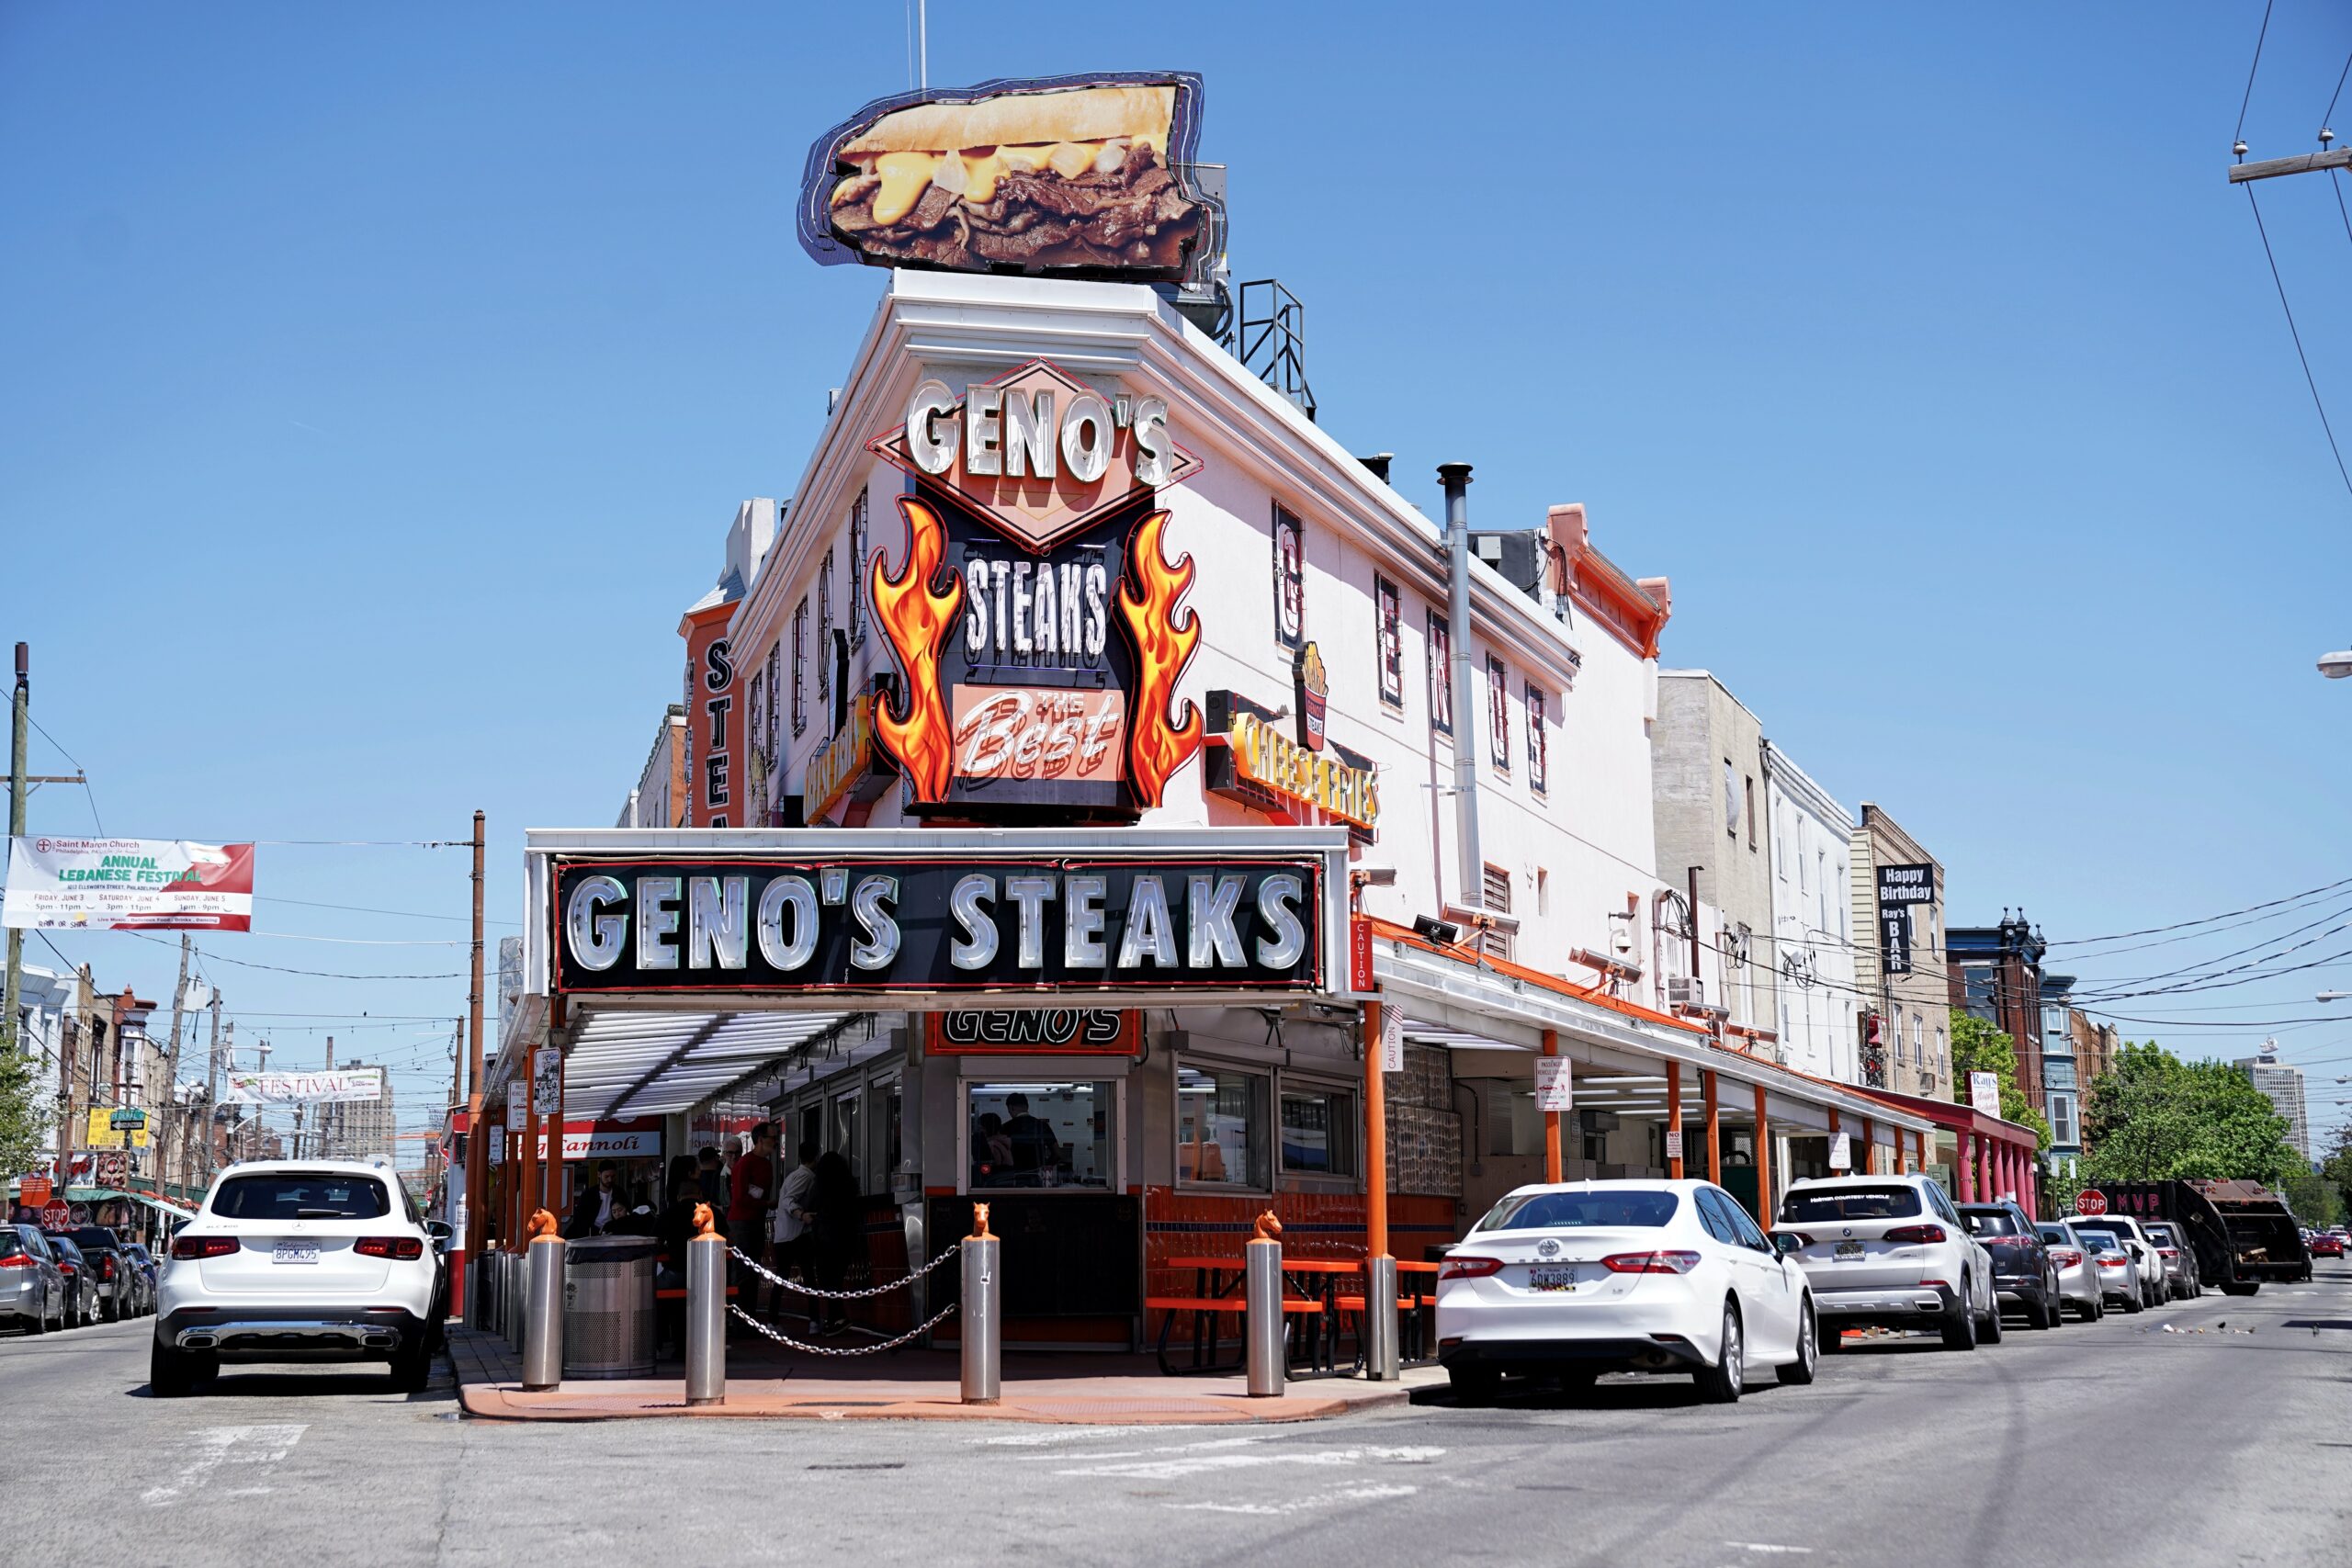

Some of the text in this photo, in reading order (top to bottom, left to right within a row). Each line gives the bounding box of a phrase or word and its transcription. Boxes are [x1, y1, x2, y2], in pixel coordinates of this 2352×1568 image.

[908, 378, 1174, 487] GENO'S
[967, 558, 1106, 656] STEAKS
[1037, 692, 1084, 713] THE
[958, 690, 1121, 773] Best
[56, 840, 78, 848] Saint
[81, 840, 107, 849] Maron
[109, 840, 140, 849] Church
[101, 855, 159, 869] ANNUAL
[59, 868, 201, 882] LEBANESE FESTIVAL
[1885, 868, 1924, 884] Happy
[1880, 885, 1931, 900] Birthday
[106, 903, 123, 911] 3pm
[202, 904, 220, 912] 9pm
[1882, 908, 1905, 919] Ray's
[38, 919, 54, 928] RAIN
[70, 919, 88, 929] SHINE
[567, 869, 1306, 971] GENO'S STEAKS
[1888, 920, 1902, 970] BAR
[1357, 923, 1365, 987] CAUTION
[946, 1009, 1121, 1043] GENO'S
[1387, 1026, 1396, 1069] CAUTION
[259, 1077, 349, 1094] FESTIVAL
[1973, 1073, 1997, 1090] Ray's
[2078, 1198, 2105, 1210] STOP
[2116, 1193, 2160, 1212] MVP
[45, 1209, 69, 1222] STOP
[1531, 1272, 1575, 1287] 6DW3889
